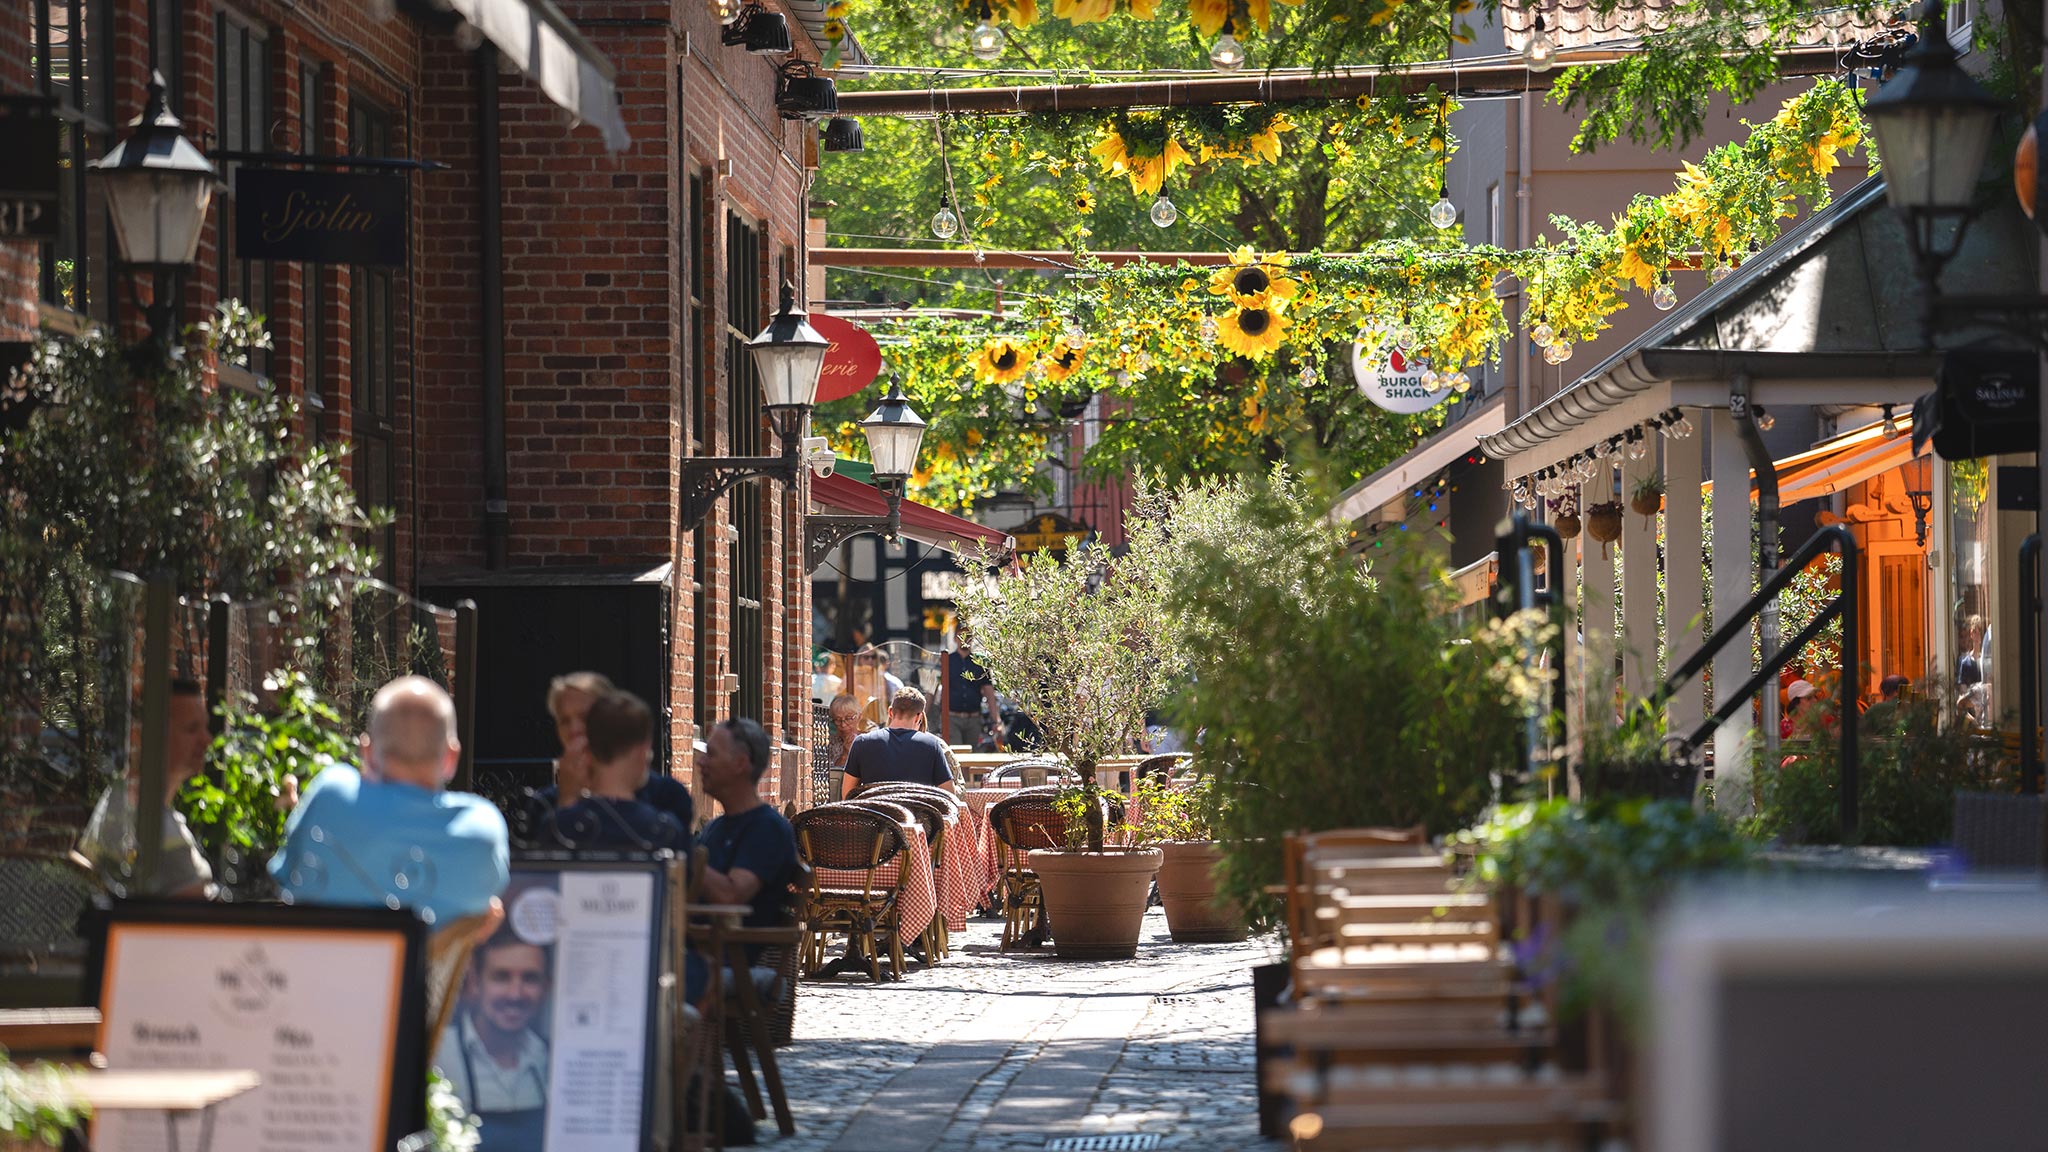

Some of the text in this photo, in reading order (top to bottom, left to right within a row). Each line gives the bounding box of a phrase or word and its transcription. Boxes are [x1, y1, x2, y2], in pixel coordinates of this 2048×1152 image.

[261, 191, 380, 243] Sjölin
[1380, 377, 1424, 387] BURG
[1385, 388, 1431, 398] SHACK
[1730, 395, 1745, 411] 52
